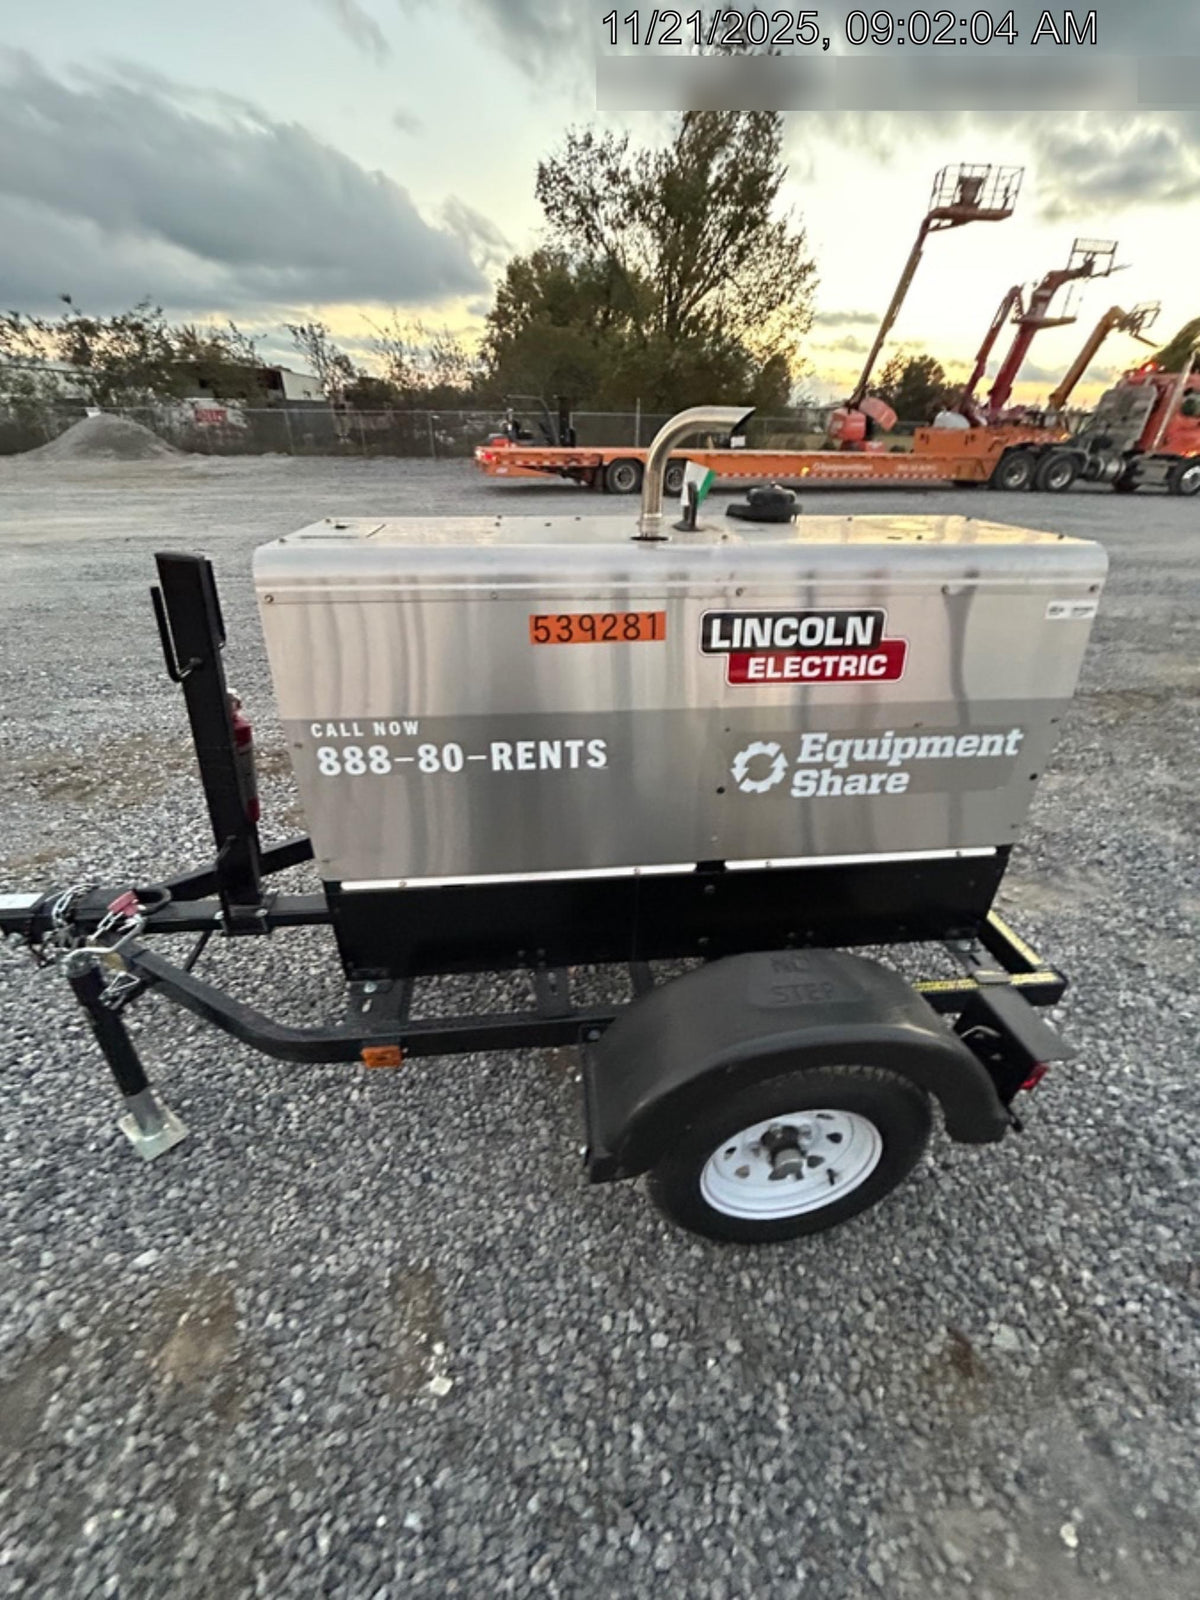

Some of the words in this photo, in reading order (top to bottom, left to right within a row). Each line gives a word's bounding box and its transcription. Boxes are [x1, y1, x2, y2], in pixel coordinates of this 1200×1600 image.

[533, 613, 658, 643] 539281
[710, 616, 875, 648] LINCOLN
[747, 654, 888, 680] ELECTRIC
[310, 722, 364, 737] CALL
[373, 720, 419, 736] NOW
[316, 739, 608, 776] 888-80-RENTS
[797, 728, 1024, 768] Equipment
[790, 769, 910, 797] Share
[770, 982, 834, 1003] STEP
